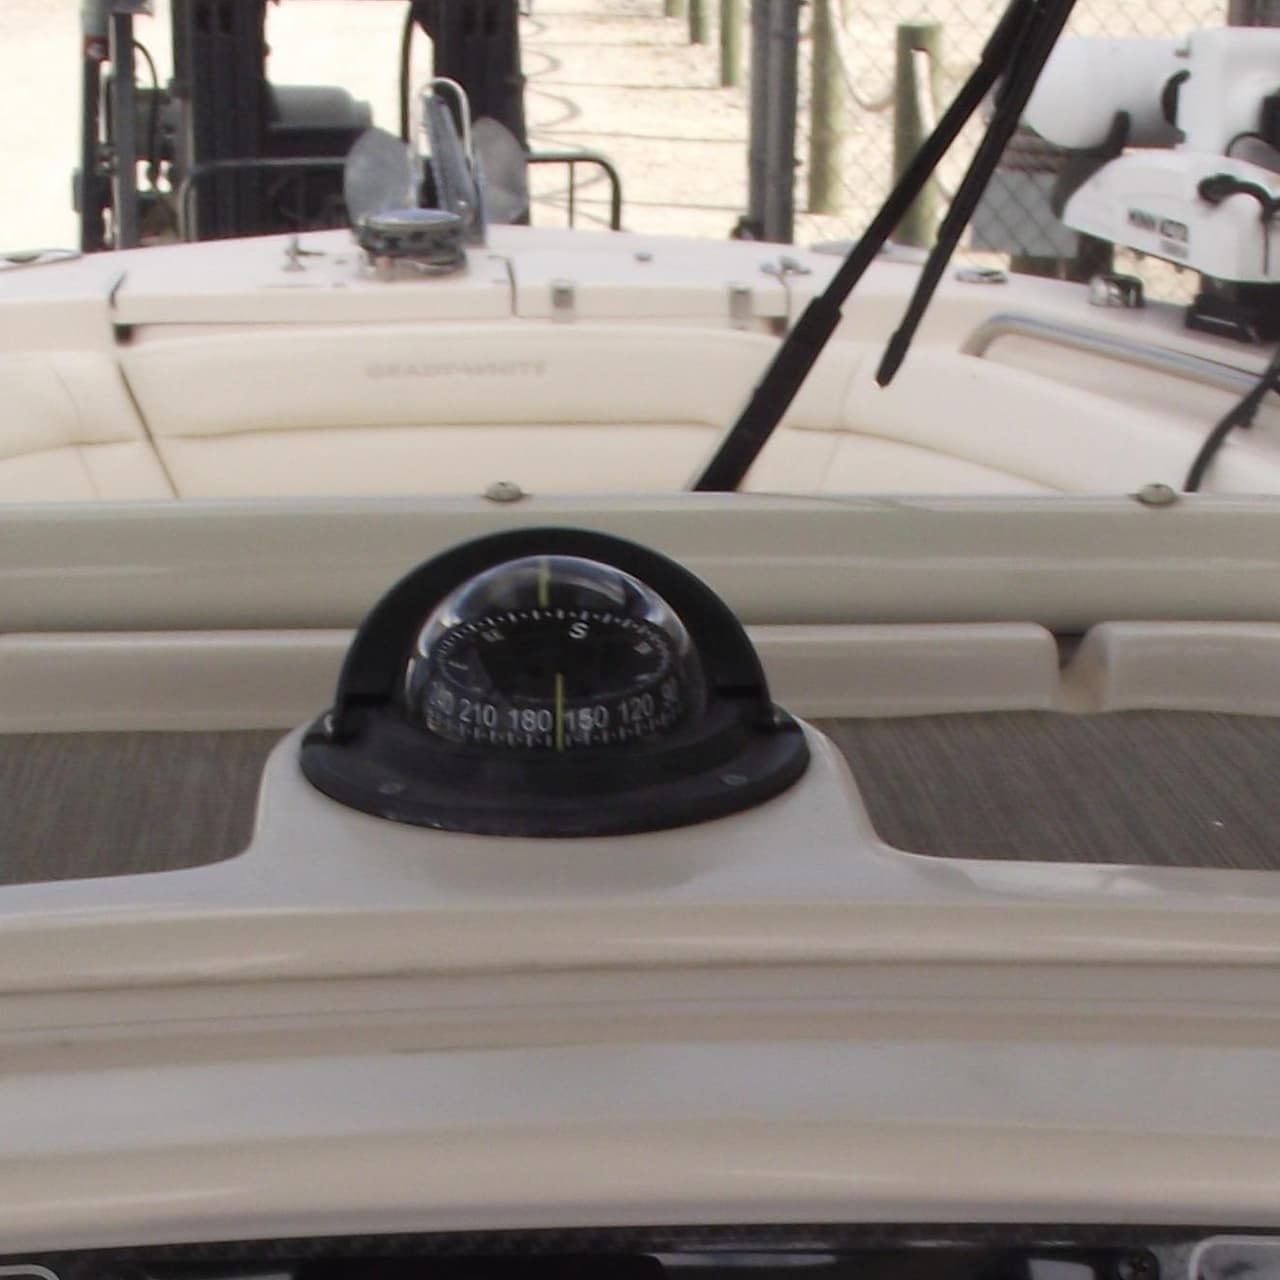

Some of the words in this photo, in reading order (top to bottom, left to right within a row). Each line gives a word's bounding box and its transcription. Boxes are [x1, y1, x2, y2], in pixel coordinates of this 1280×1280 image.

[459, 699, 497, 728] 210
[509, 708, 552, 732] 180
[565, 704, 609, 731] 150
